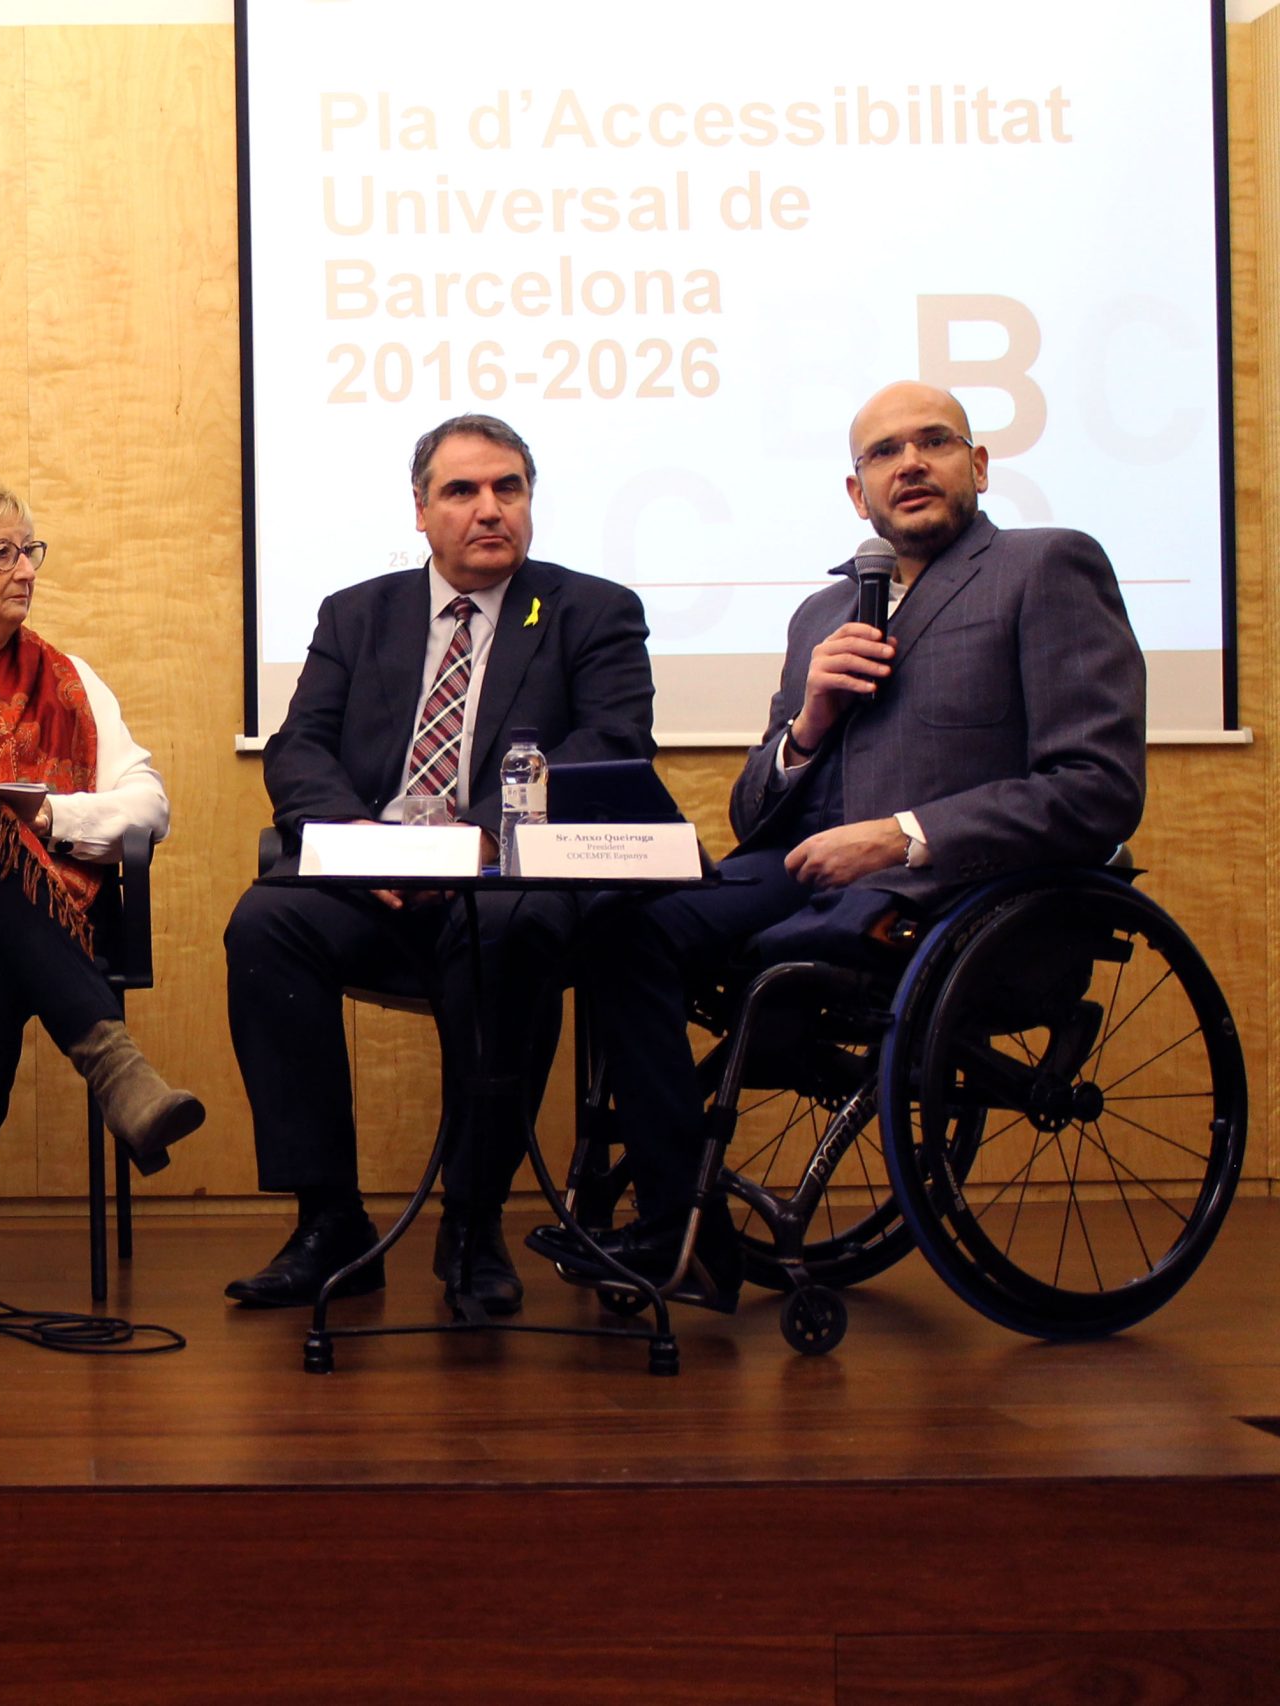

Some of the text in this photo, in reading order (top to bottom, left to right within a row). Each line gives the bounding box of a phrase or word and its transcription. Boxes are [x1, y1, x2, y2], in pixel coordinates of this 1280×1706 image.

[317, 89, 438, 152] Pla
[320, 171, 812, 236] Universal de
[323, 256, 724, 321] Barcelona
[325, 337, 722, 405] 2016-2026
[388, 551, 409, 567] 25
[555, 833, 654, 843] Sr. Anxo Queiruga
[566, 851, 612, 861] COCEMFE
[586, 843, 625, 851] President
